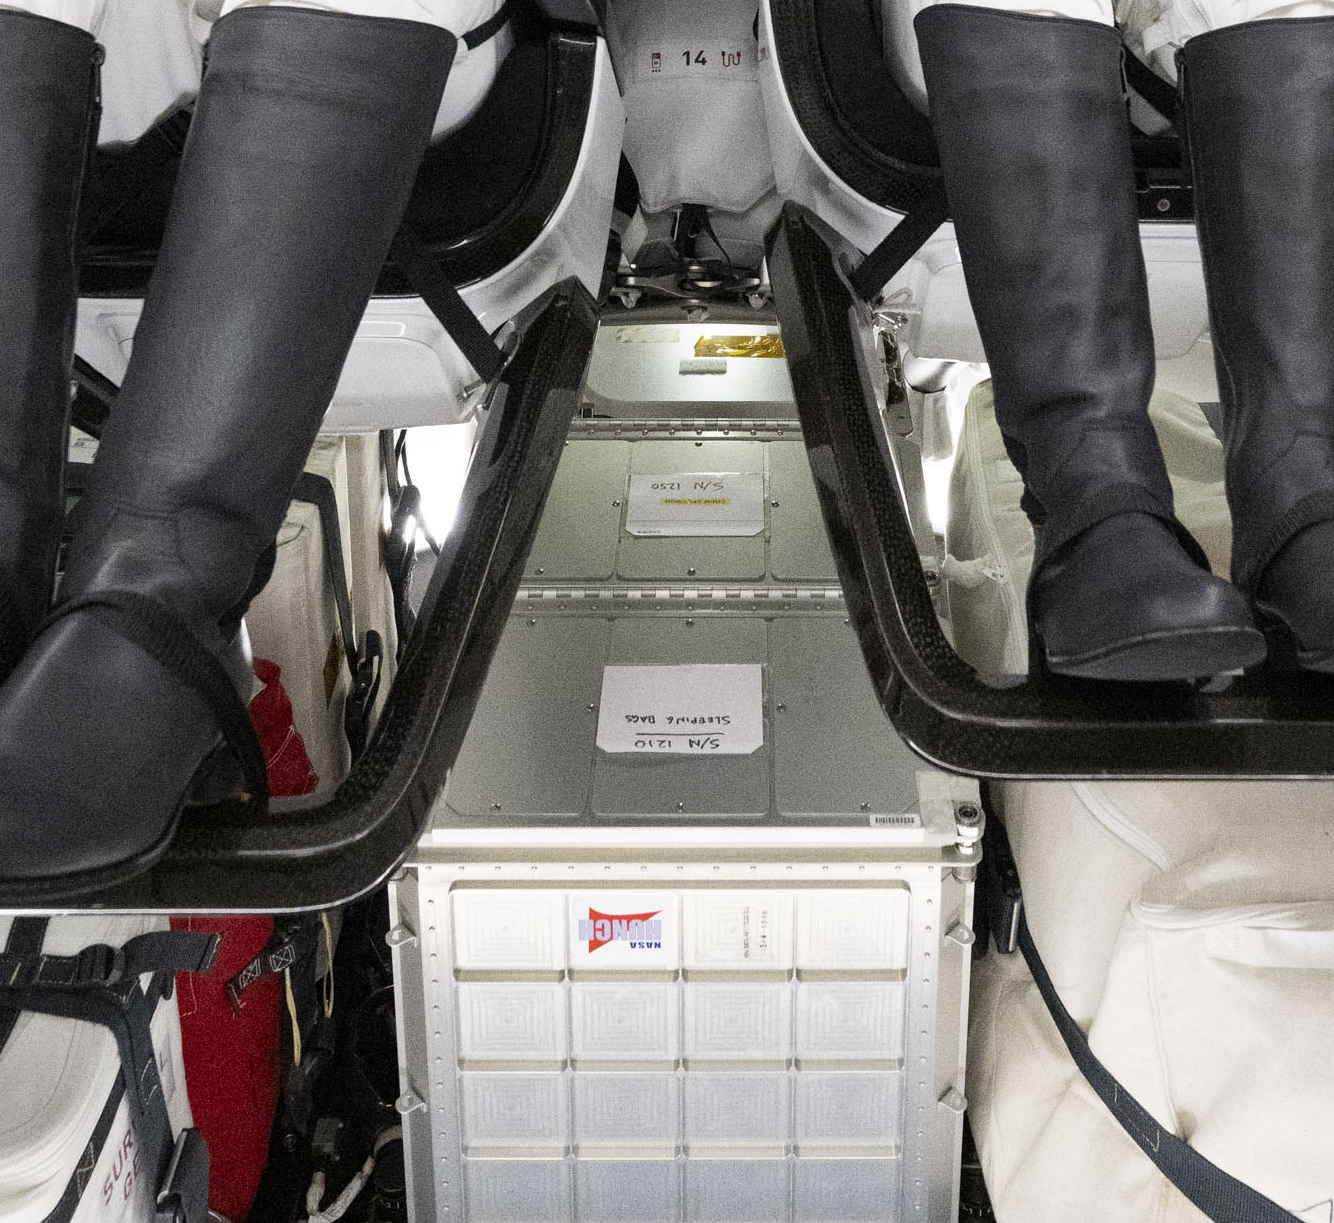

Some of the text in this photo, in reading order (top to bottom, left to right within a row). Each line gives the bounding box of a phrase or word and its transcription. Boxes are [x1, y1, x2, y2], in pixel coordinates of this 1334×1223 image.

[682, 50, 707, 66] 14
[651, 481, 724, 491] S/N 1250
[624, 714, 731, 726] SLEEPING BAGS
[634, 737, 721, 750] S/N 1210
[578, 919, 662, 942] HUNCH
[629, 941, 662, 950] NASA
